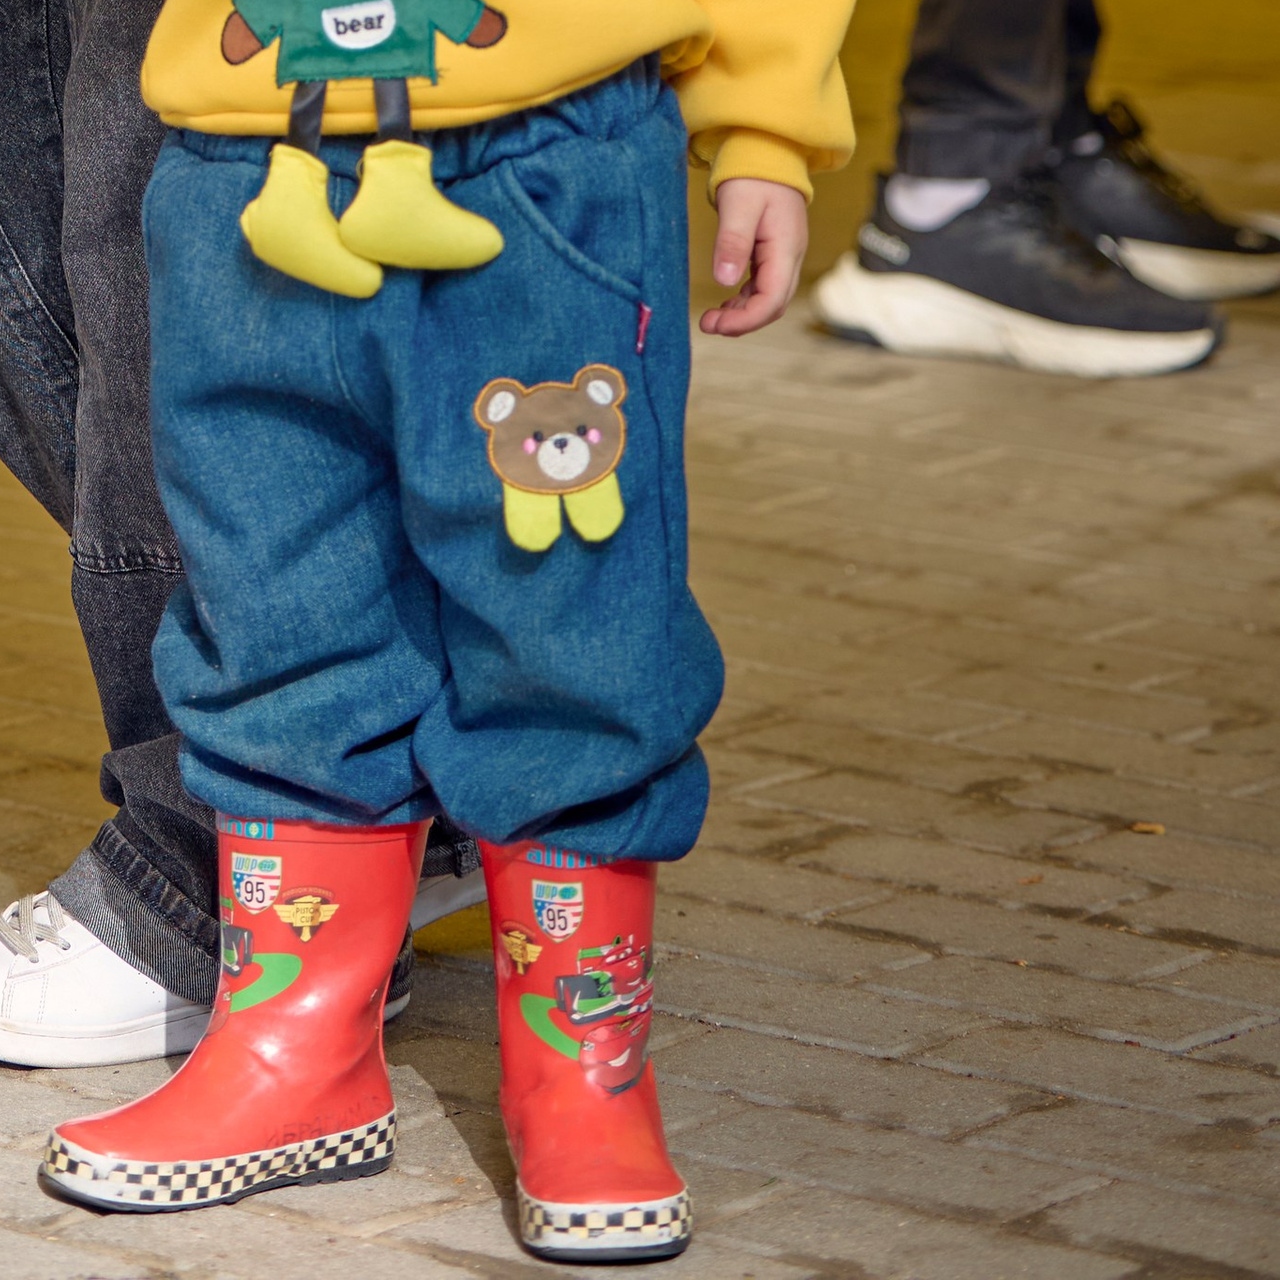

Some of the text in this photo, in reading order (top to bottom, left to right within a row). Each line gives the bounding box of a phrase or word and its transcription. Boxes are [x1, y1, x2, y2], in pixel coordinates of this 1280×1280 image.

[333, 14, 385, 36] bear
[244, 880, 266, 904] 95
[300, 915, 316, 924] CUP
[546, 908, 568, 931] 95
